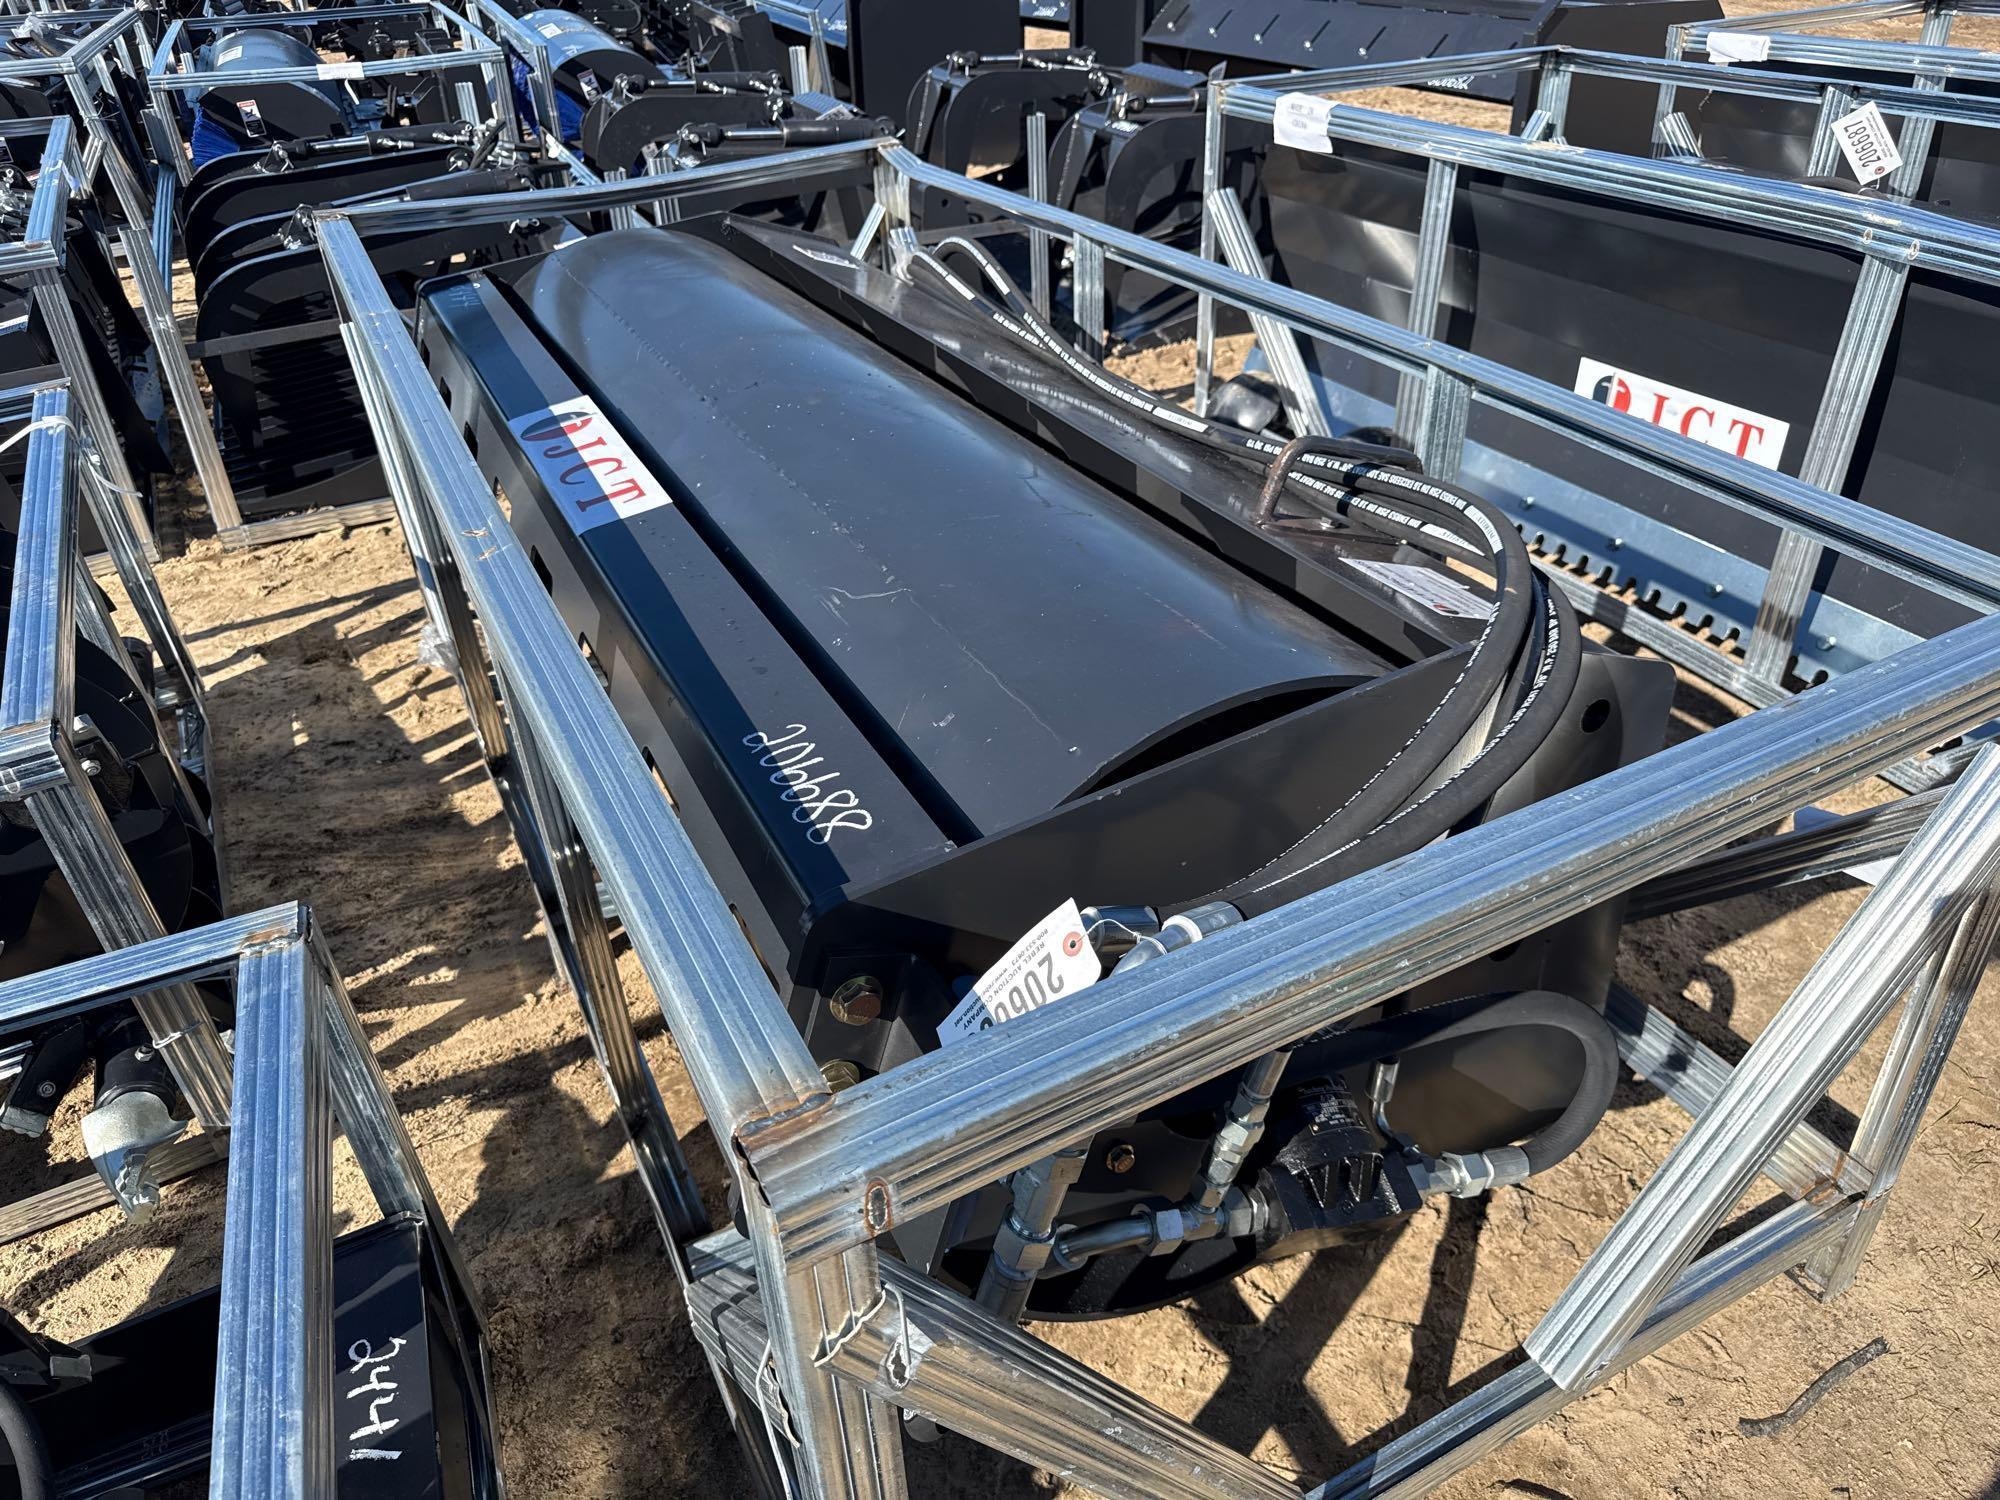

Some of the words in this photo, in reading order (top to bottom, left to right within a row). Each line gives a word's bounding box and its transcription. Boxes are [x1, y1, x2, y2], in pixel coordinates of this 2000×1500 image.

[1843, 120, 1882, 168] 206687
[1301, 452, 1314, 464] BAR
[1313, 455, 1325, 466] 250
[742, 723, 872, 845] 206688
[1022, 941, 1046, 965] REBEL
[994, 964, 1023, 997] AUCTION
[963, 995, 994, 1031] COMPANY
